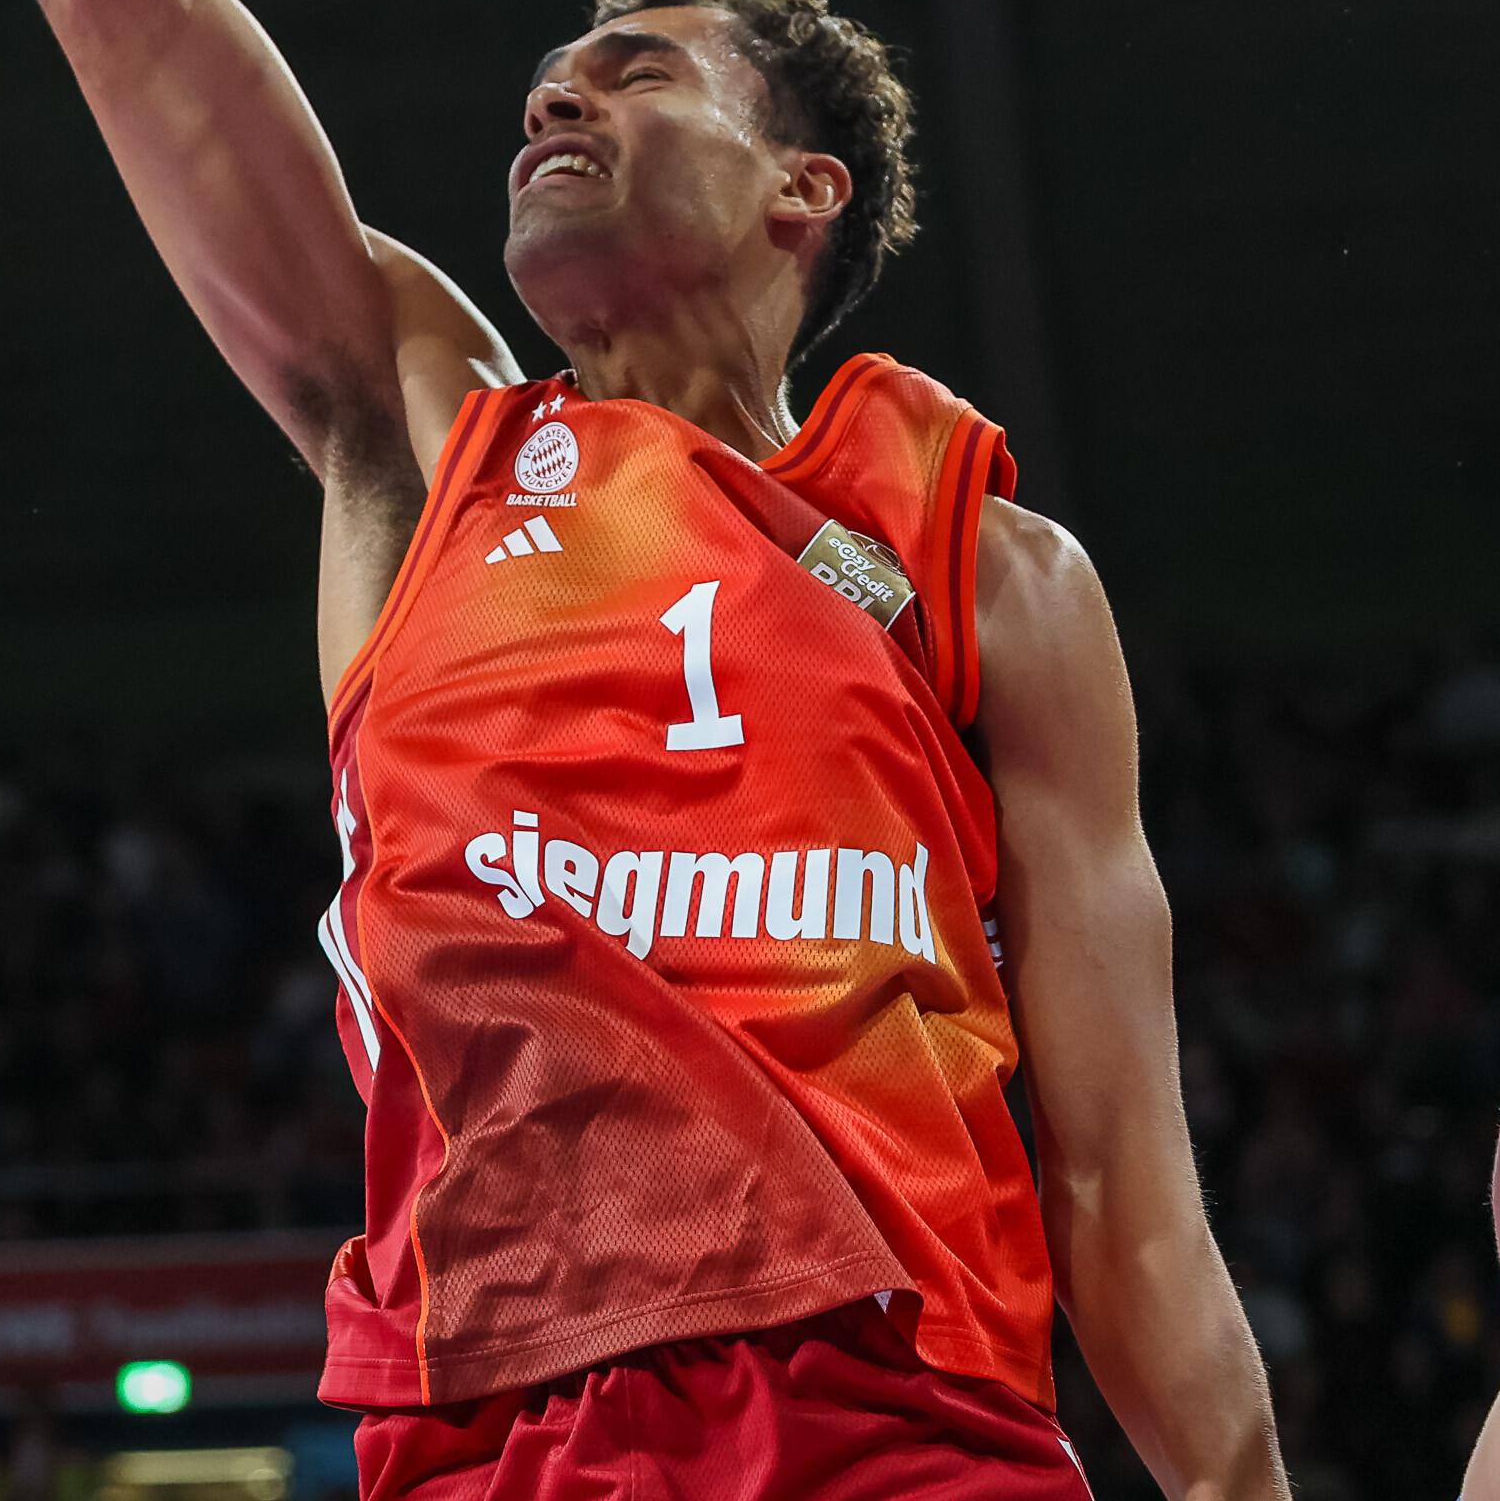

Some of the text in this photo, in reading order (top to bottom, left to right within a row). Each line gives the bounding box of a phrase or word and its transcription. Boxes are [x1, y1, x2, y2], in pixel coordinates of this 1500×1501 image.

[538, 428, 571, 449] BAYERN
[506, 492, 578, 508] BASKETBALL
[840, 559, 895, 603] Credit
[658, 580, 745, 751] 1
[464, 809, 937, 965] siegmund
